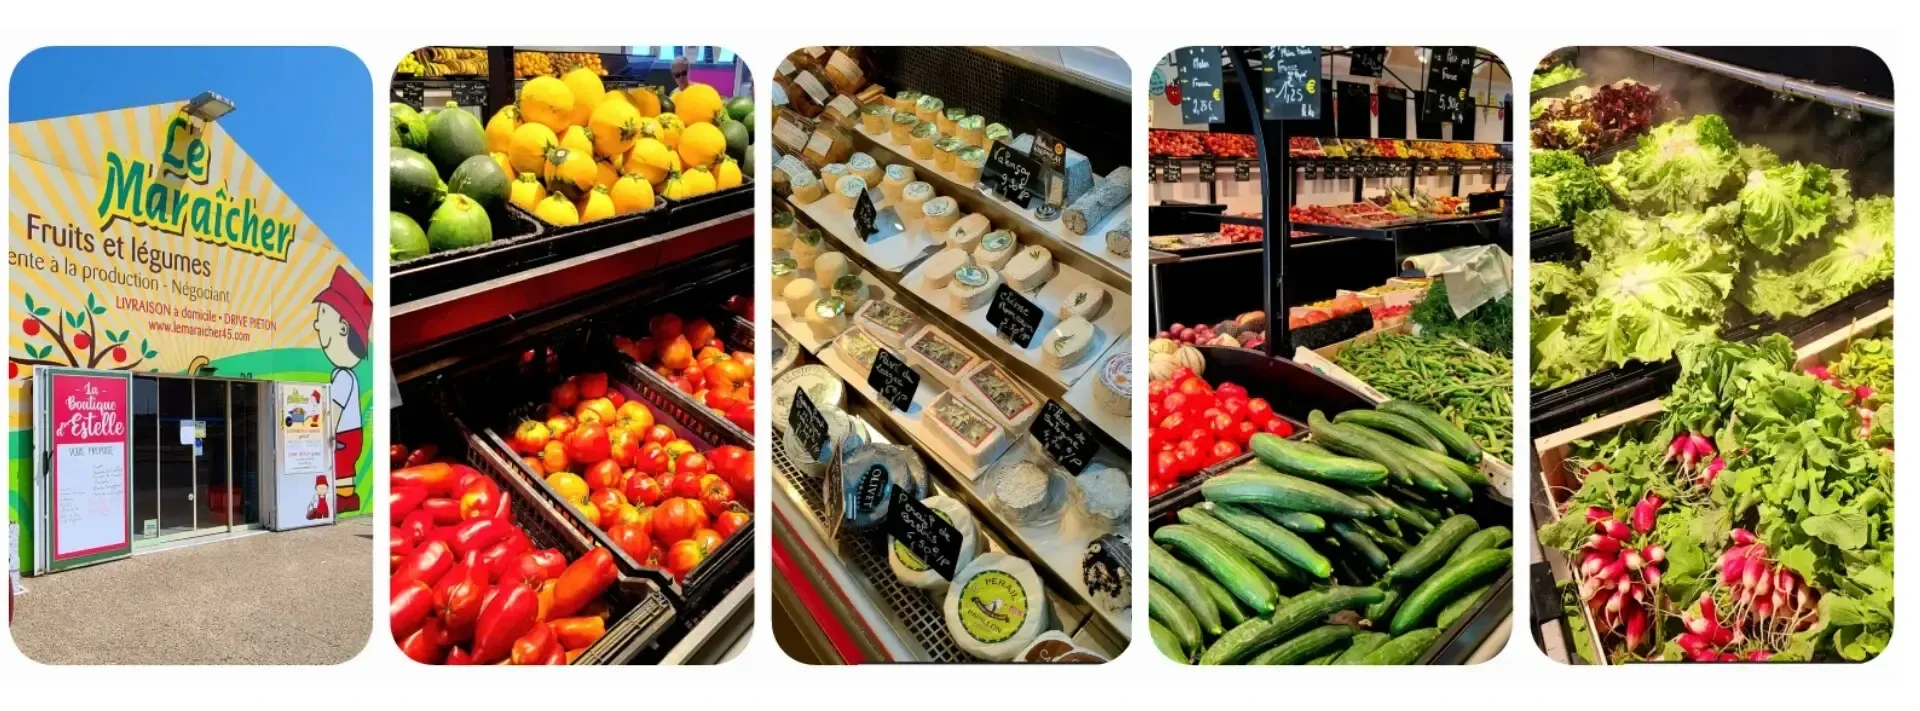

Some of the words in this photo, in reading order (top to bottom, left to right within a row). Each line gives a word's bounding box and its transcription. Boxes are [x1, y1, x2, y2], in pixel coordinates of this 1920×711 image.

[163, 116, 205, 176] Le
[97, 151, 292, 254] Maraîcher
[27, 213, 95, 253] Fruits
[103, 237, 124, 261] et
[131, 236, 211, 278] légumes
[50, 256, 59, 273] à
[65, 256, 77, 277] la
[82, 265, 159, 291] production
[171, 279, 230, 303] Négociant
[115, 296, 171, 317] LIVRAISON
[173, 306, 179, 318] à
[181, 307, 216, 322] domicile
[224, 312, 248, 328] DRIVE
[148, 320, 250, 342] www.lemaraicher45.com
[65, 395, 117, 416] Boutique
[83, 381, 99, 396] La
[863, 468, 882, 509] OLIVET
[985, 577, 1019, 602] PERAIL
